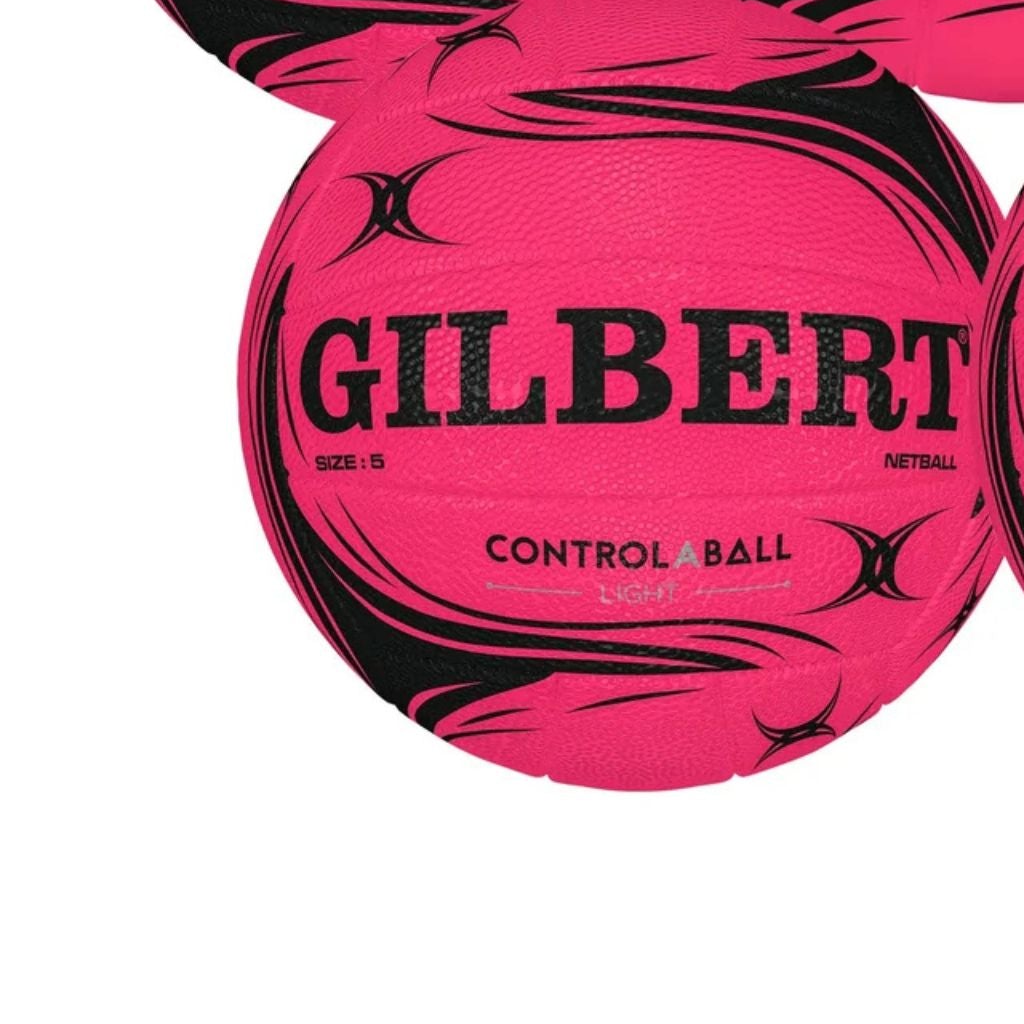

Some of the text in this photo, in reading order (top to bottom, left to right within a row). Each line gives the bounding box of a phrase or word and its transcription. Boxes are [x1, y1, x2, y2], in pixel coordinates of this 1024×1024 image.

[369, 453, 385, 471] 5
[884, 452, 958, 471] NETBALL
[598, 582, 680, 605] LIGHT
